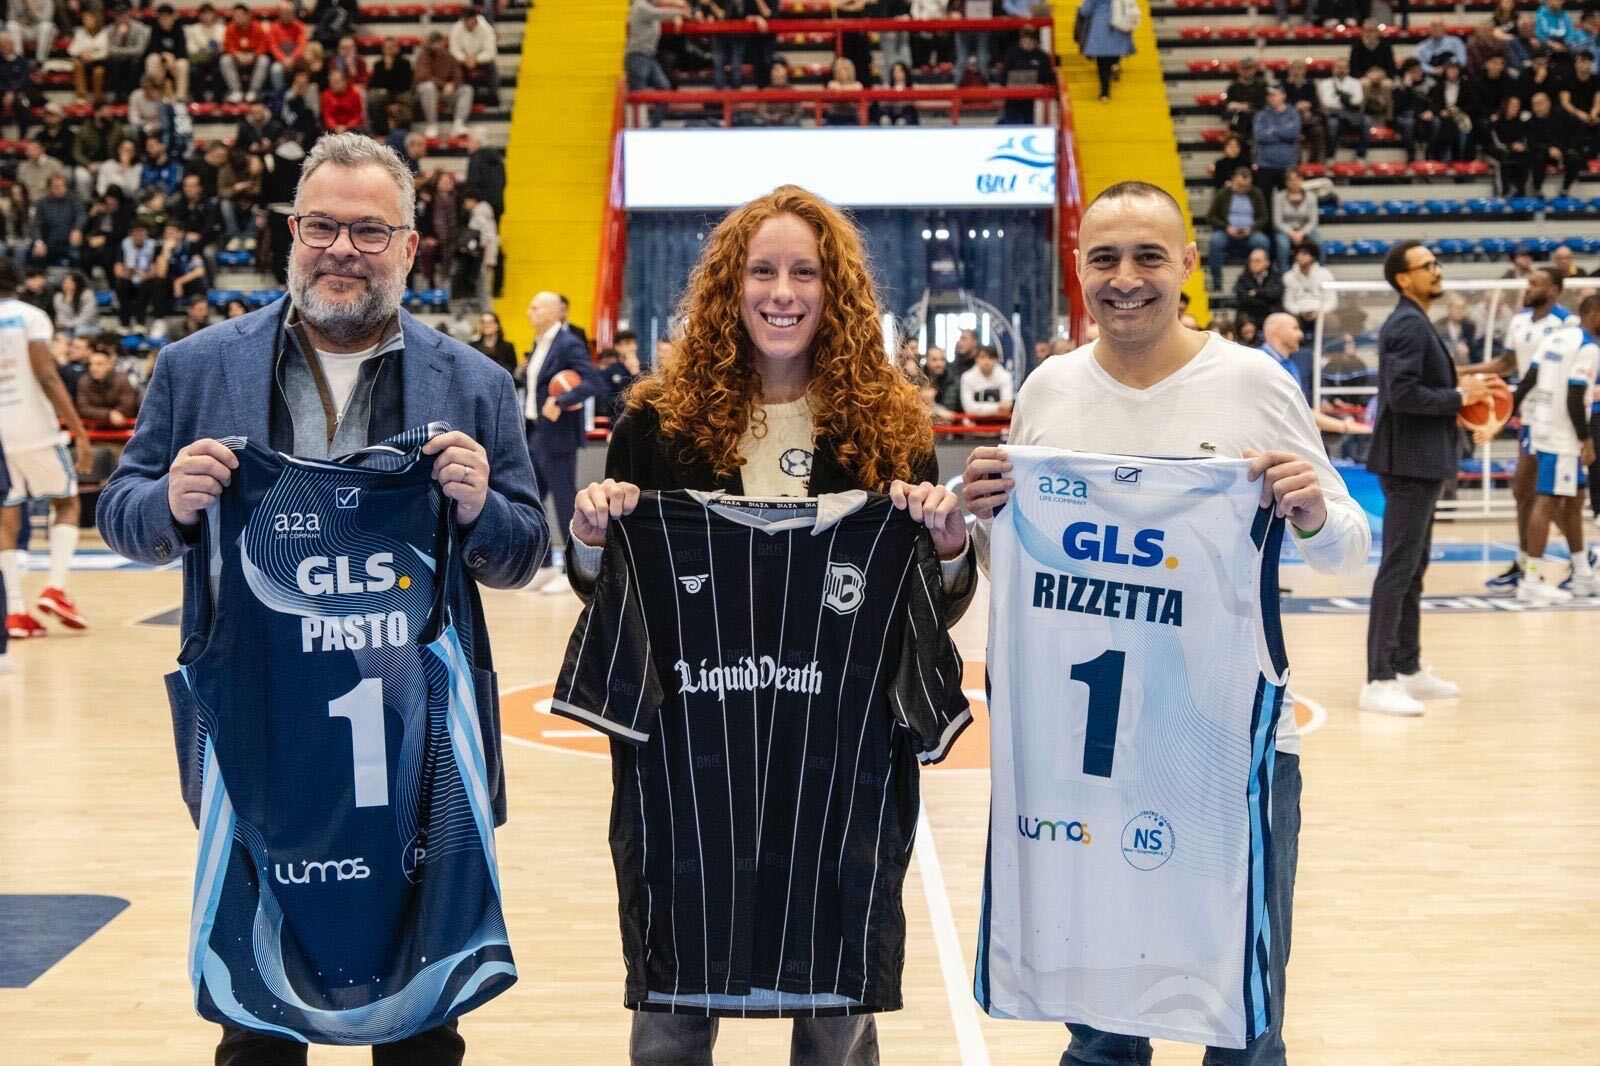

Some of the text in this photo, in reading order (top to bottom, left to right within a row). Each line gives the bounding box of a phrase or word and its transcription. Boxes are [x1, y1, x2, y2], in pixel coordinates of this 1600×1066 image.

[1038, 476, 1088, 498] a2a
[1053, 496, 1087, 506] COMPANY
[274, 512, 320, 532] a2a
[1032, 571, 1183, 627] RIZZETTA
[301, 611, 408, 653] PASTO
[1070, 649, 1126, 778] 1
[328, 677, 389, 808] 1
[1133, 828, 1162, 851] NS
